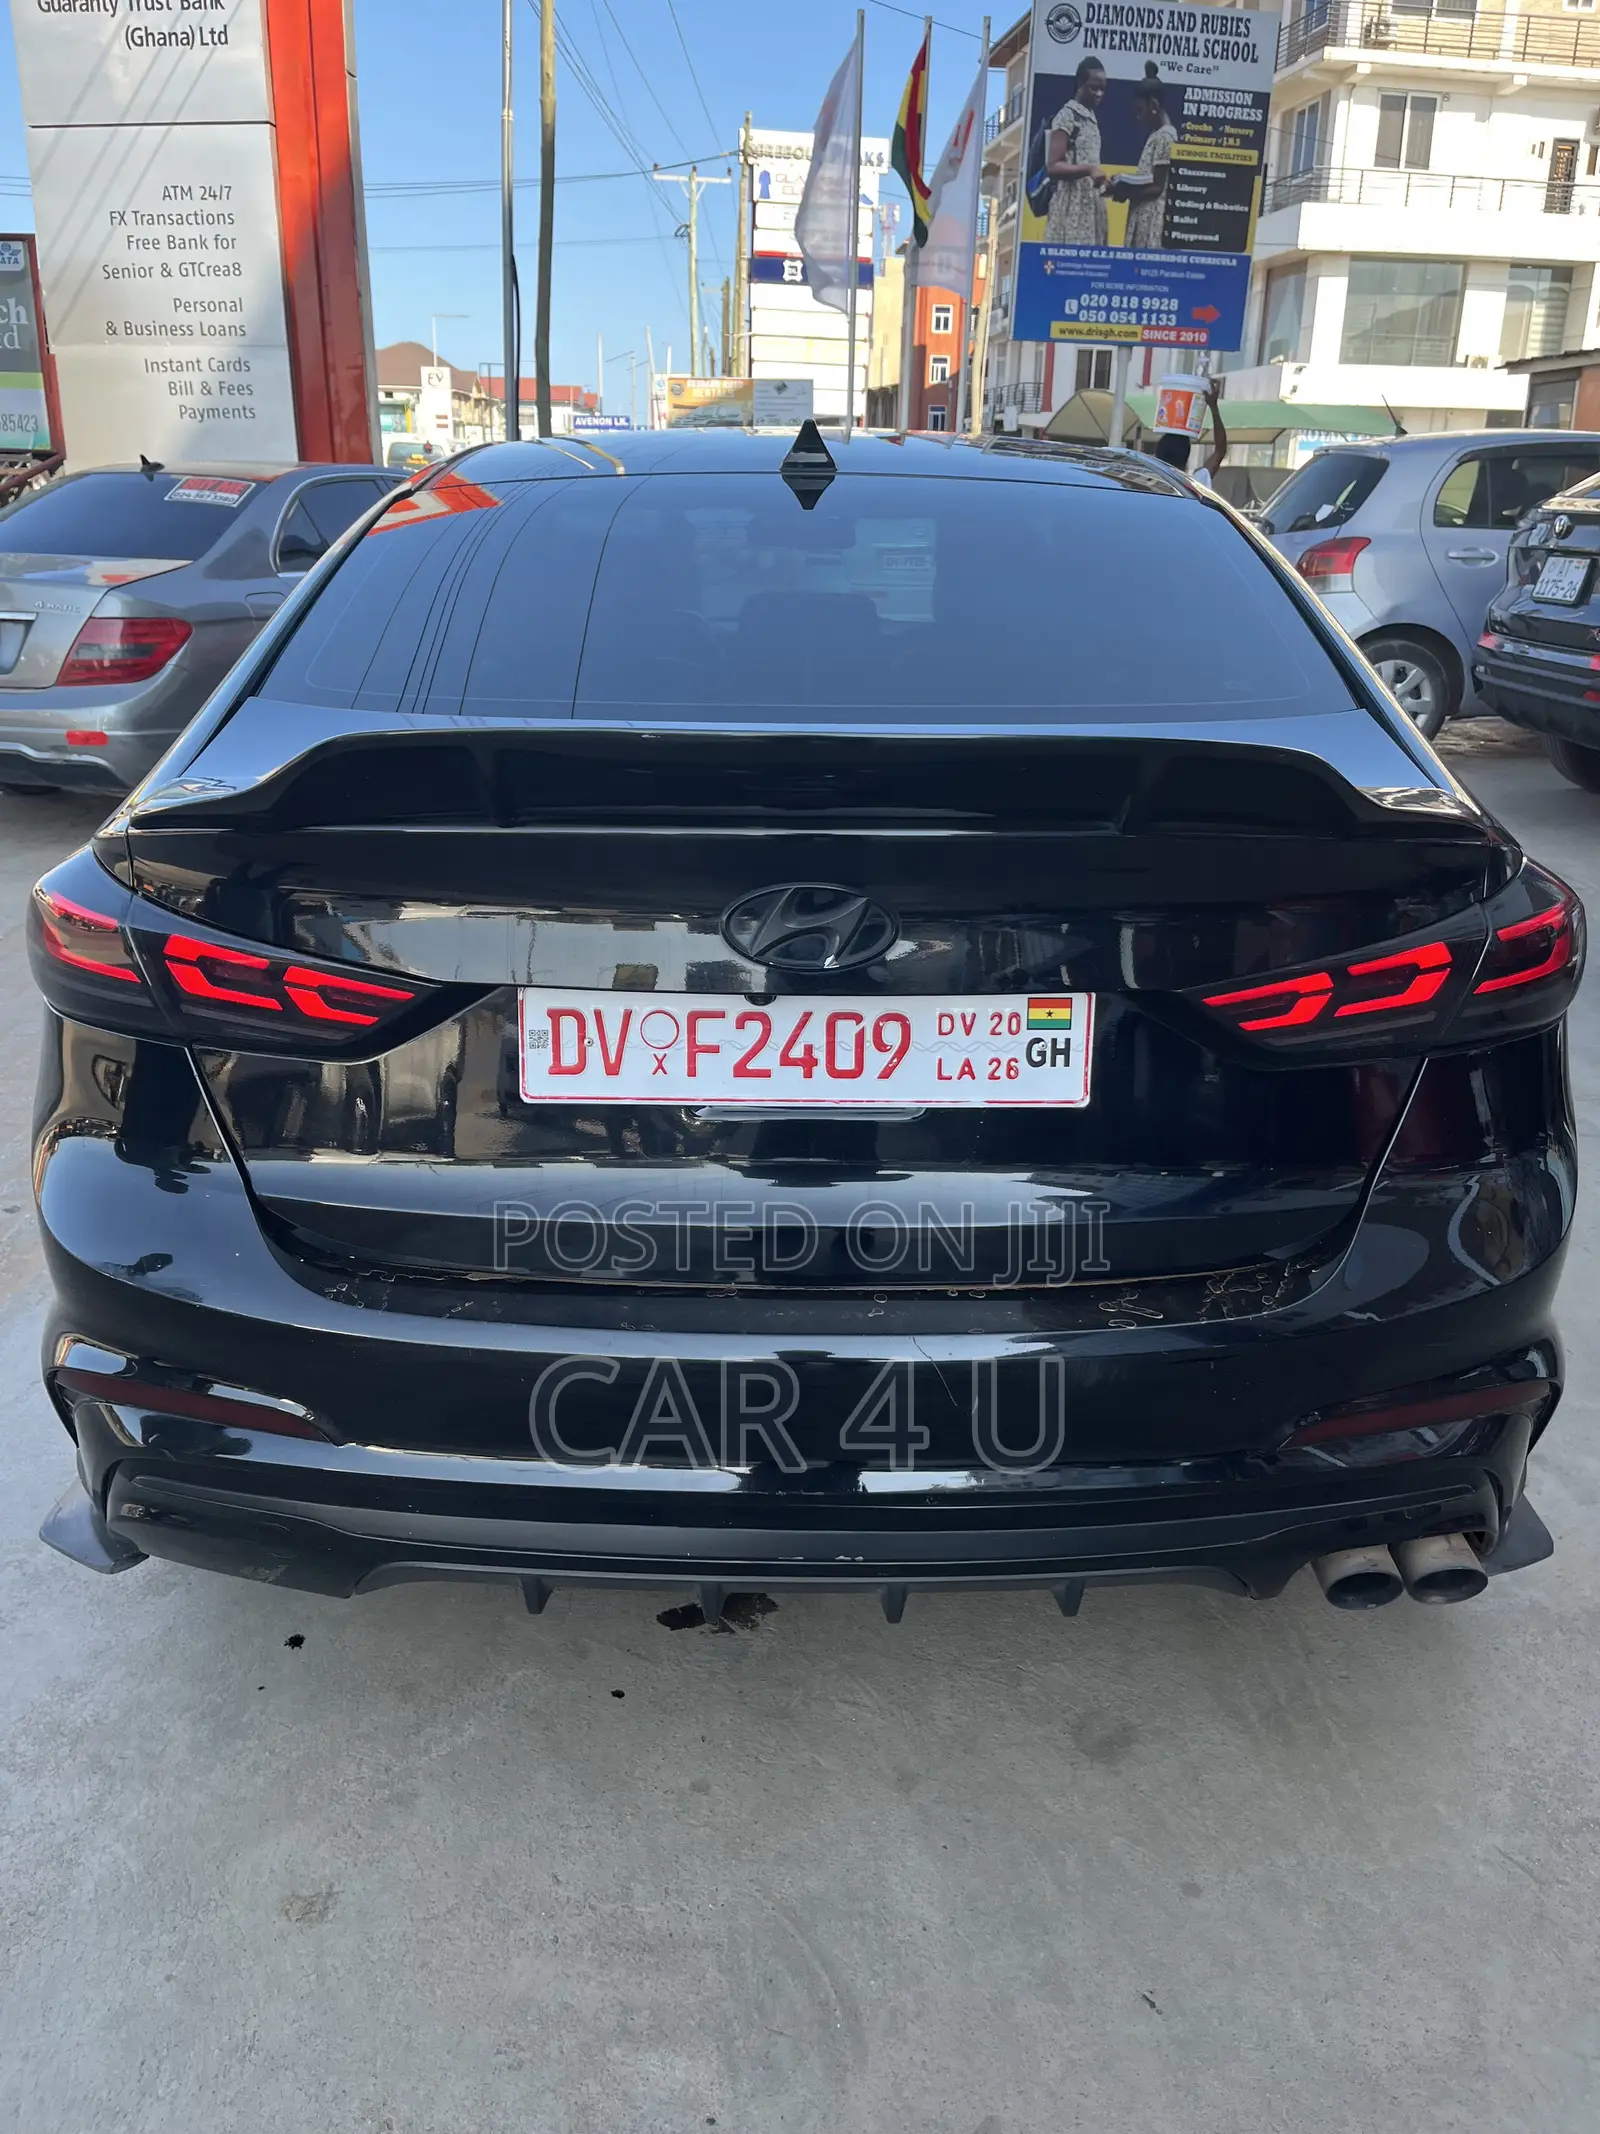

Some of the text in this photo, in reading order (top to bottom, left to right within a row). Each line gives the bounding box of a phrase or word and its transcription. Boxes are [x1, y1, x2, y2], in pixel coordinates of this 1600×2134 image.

[1085, 2, 1163, 28] DIAMONDS
[1166, 11, 1196, 32] AND
[1200, 13, 1252, 38] RUBIES
[125, 25, 229, 50] (Ghana) Ltd
[1083, 27, 1259, 63] INTERNATIONAL SCHOOL
[1184, 87, 1253, 106] ADMISSION
[1183, 102, 1263, 121] IN PROGRESS
[1178, 168, 1226, 178] Classrooms
[162, 184, 232, 201] ATM 24/7
[1176, 184, 1207, 195] Library
[1175, 200, 1205, 211] Coding
[1213, 203, 1249, 212] Robotics
[109, 209, 235, 226] FX Transactions
[127, 234, 237, 250] Free Bank for
[1171, 231, 1219, 242] Playground
[1040, 248, 1046, 256] A
[1047, 248, 1077, 257] BLEND
[1079, 249, 1090, 258] OF
[1115, 251, 1134, 260] AND
[1135, 252, 1188, 264] CAMBRIDGE
[1189, 256, 1237, 266] CURRICULA
[102, 261, 242, 280] Senior & GTCrea8
[173, 297, 243, 313] Personal
[1080, 293, 1179, 311] 020 818 9928
[1079, 310, 1177, 326] 050 054 1133
[105, 320, 246, 336] & Business Loans
[1059, 326, 1138, 339] www.drisgh.com
[1142, 329, 1208, 342] SINCE 2010
[144, 357, 251, 373] Instant Cards
[168, 380, 254, 396] Bill & Fees
[178, 404, 256, 423] Payments
[0, 413, 38, 432] 85423
[937, 1011, 1021, 1036] DV 20
[546, 1008, 633, 1076] DV
[686, 1010, 912, 1080] F2409
[1025, 1037, 1071, 1068] GH
[937, 1057, 1019, 1080] LA 26
